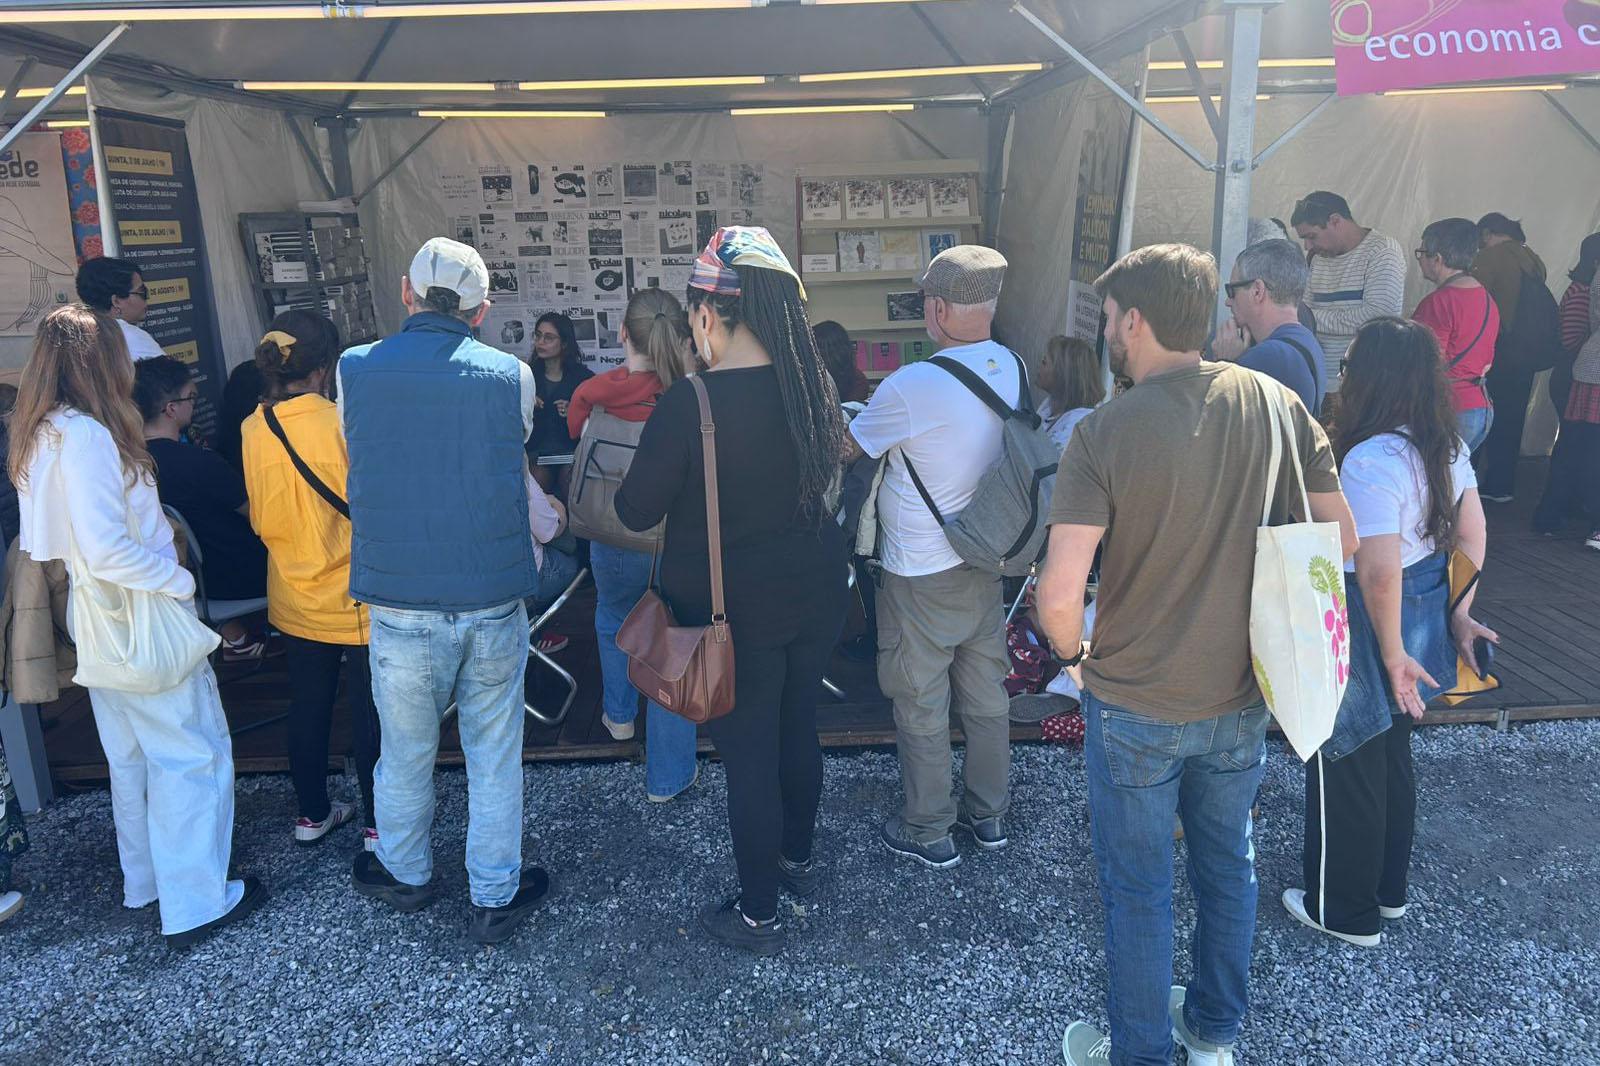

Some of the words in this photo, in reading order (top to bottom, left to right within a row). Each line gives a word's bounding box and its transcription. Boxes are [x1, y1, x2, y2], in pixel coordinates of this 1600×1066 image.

[1365, 21, 1562, 62] economia
[659, 210, 692, 219] nicolau
[1082, 218, 1109, 240] DALTON
[1079, 242, 1085, 260] E
[1086, 244, 1109, 264] MUITO
